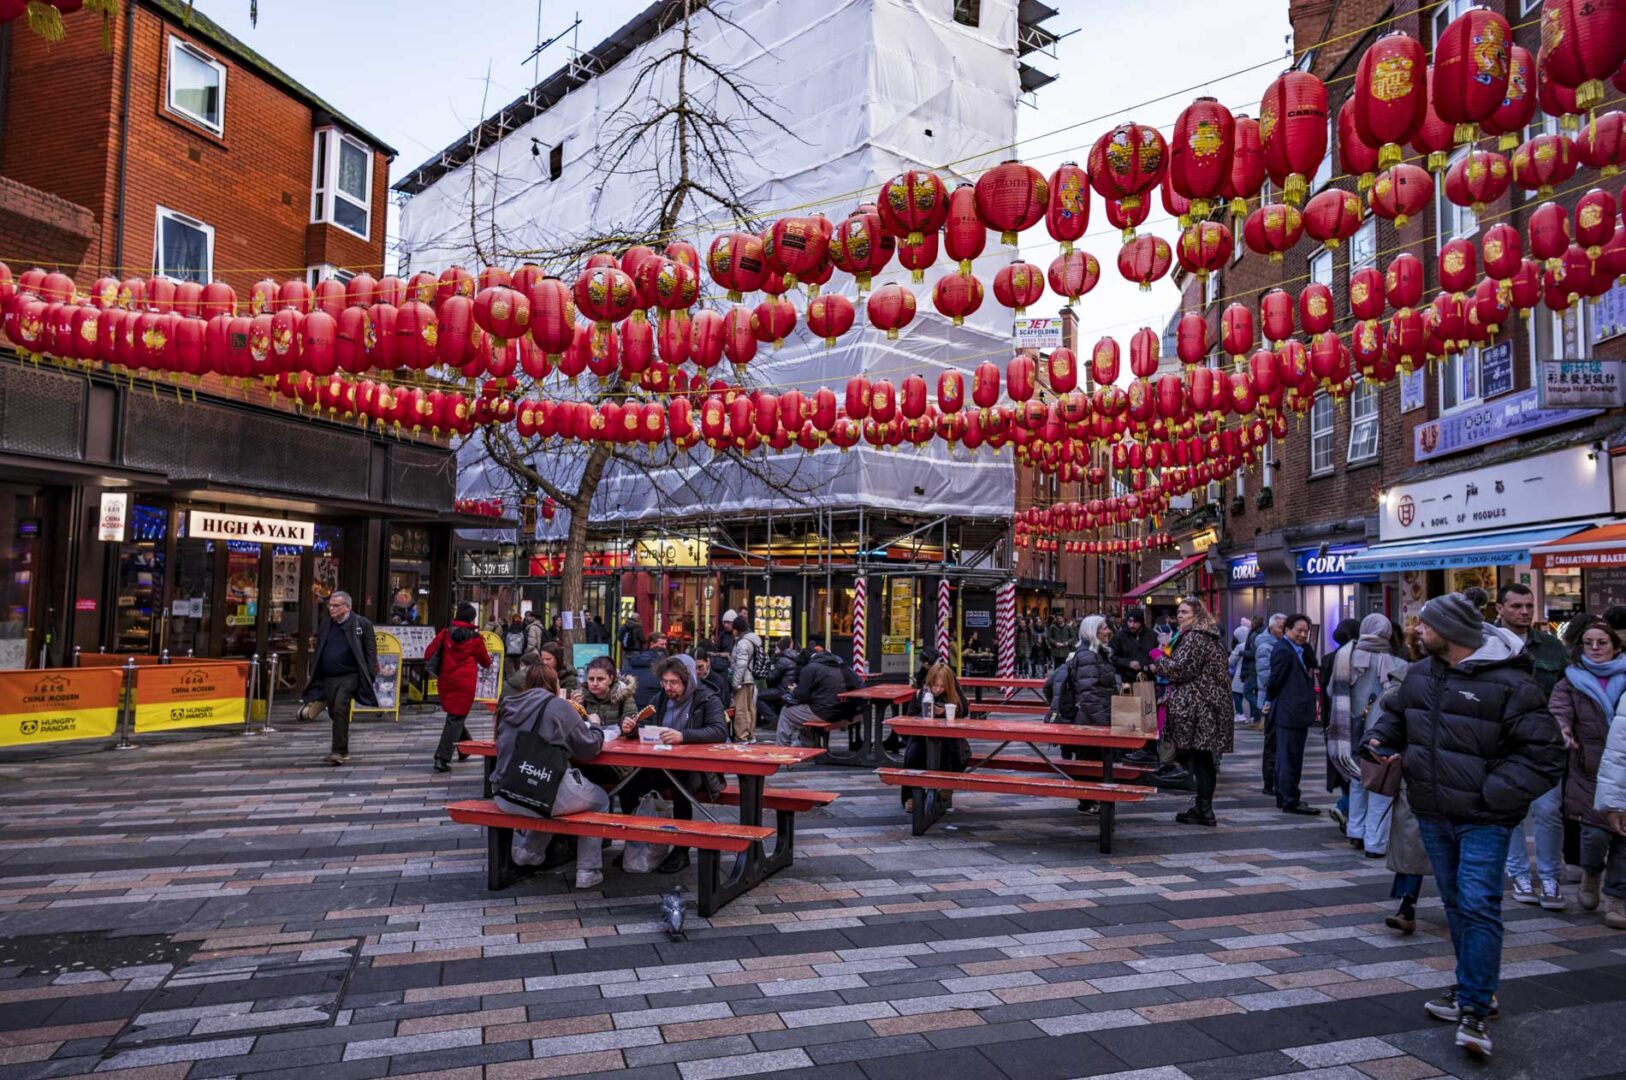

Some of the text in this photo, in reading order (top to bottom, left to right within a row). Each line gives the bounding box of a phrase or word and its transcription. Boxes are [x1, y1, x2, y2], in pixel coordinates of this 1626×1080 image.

[1028, 320, 1050, 329] JET
[1019, 328, 1059, 336] SCAFFOLDING
[1548, 384, 1618, 394] Image Hair Design
[1521, 394, 1538, 413] Worl
[1420, 508, 1507, 528] A BOWL OF NOODLES
[203, 518, 305, 540] HIGH YAKI
[1307, 555, 1347, 574] CORA
[1555, 554, 1599, 565] CHINATOWN
[497, 563, 510, 575] TEA
[1233, 563, 1257, 580] CORAL
[22, 693, 80, 704] CHINA MODERN
[41, 717, 76, 726] HUNGRY
[40, 724, 69, 733] PANDA
